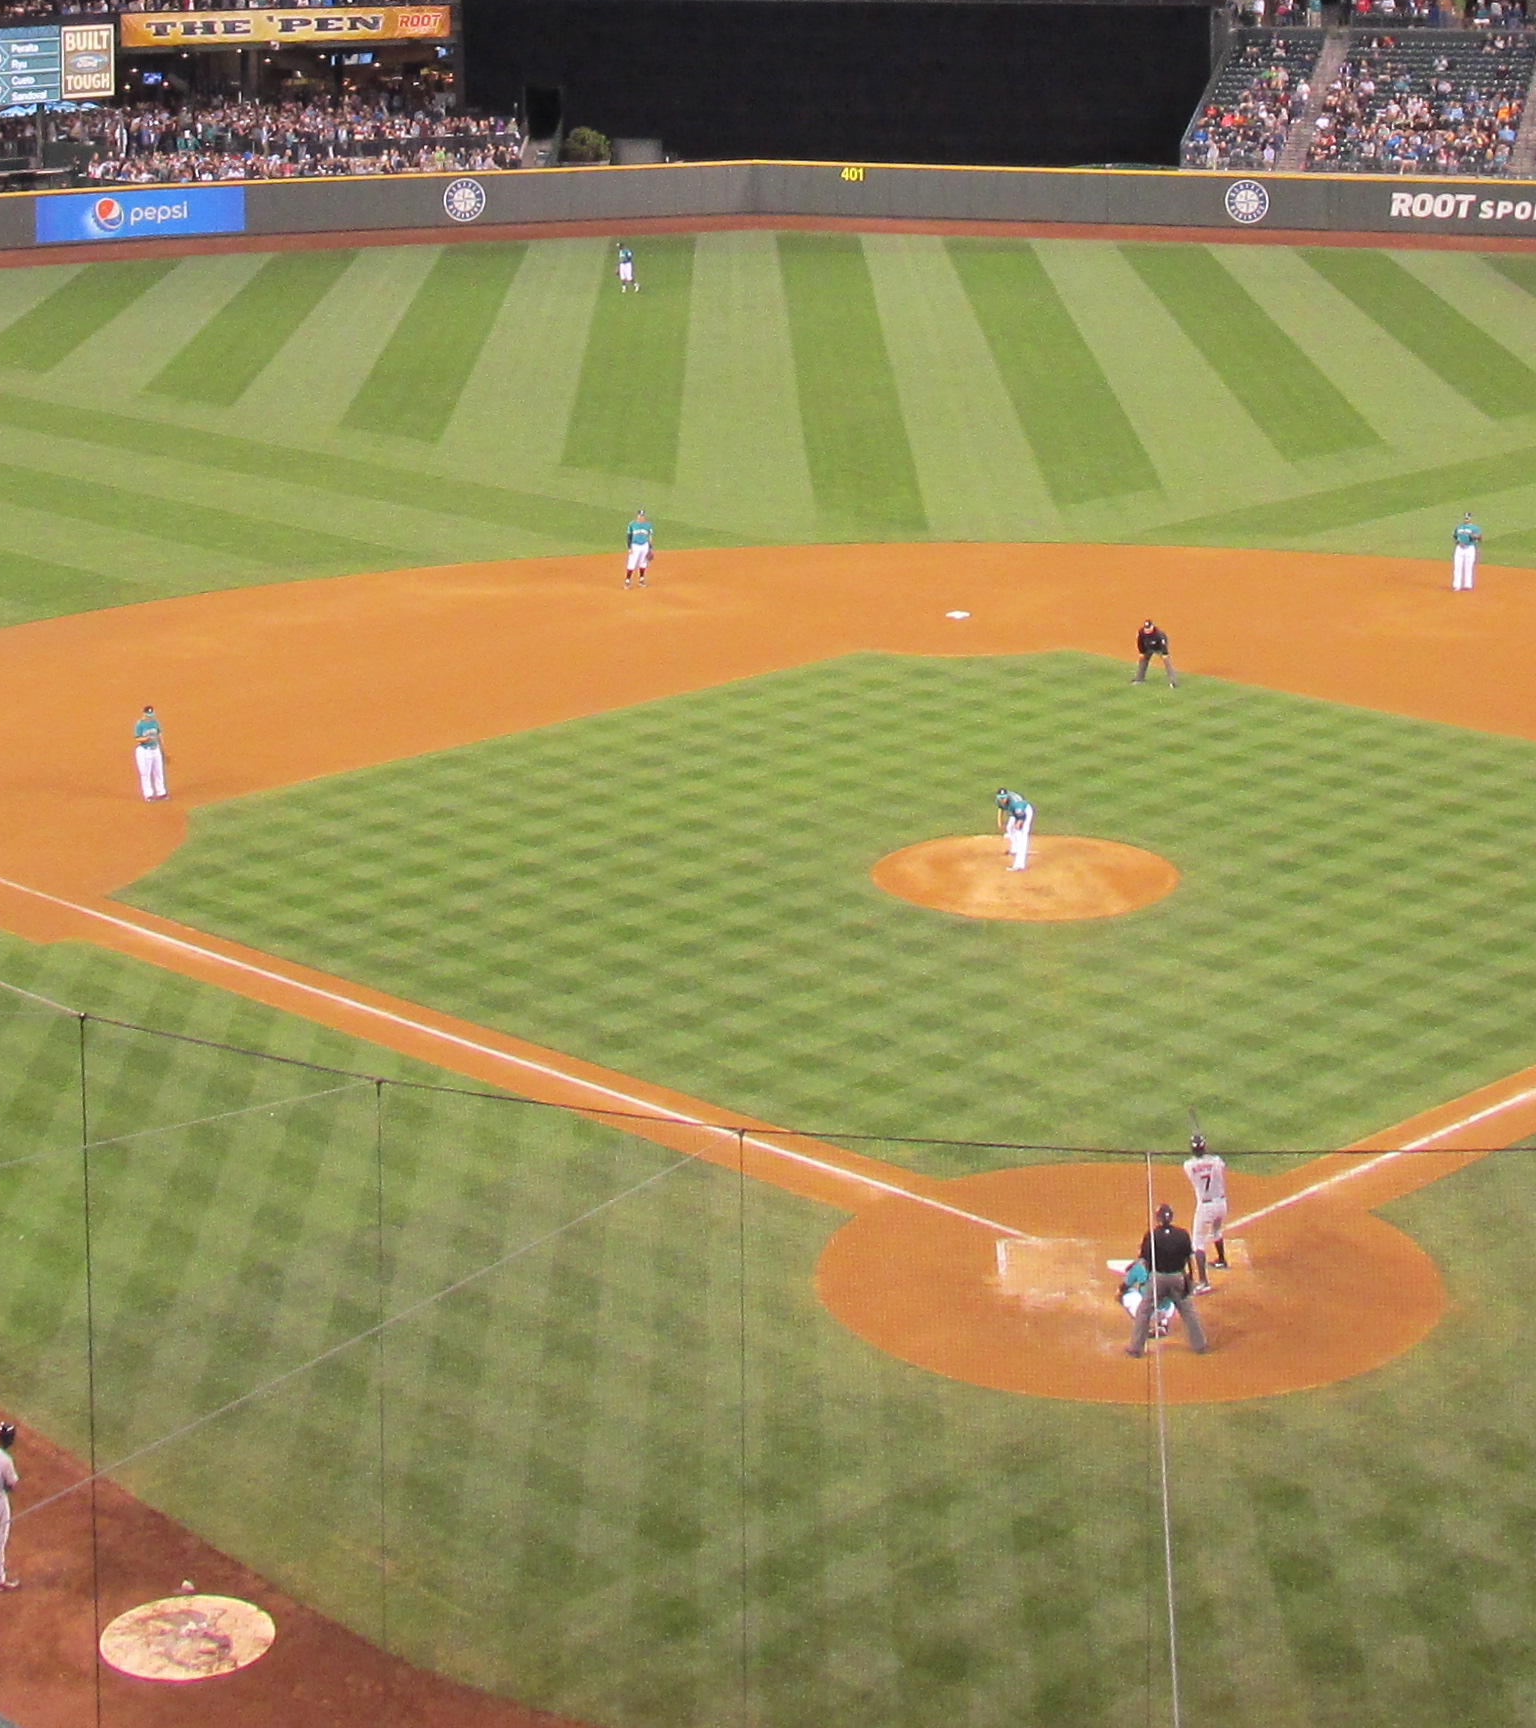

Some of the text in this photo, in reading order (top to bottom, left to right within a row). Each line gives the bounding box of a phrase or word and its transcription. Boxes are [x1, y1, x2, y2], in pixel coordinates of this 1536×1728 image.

[146, 14, 384, 37] THE 'PEN
[398, 14, 441, 28] ROOT
[66, 30, 110, 52] BUILT
[66, 73, 110, 92] TOUGH
[840, 167, 864, 182] 401
[130, 201, 188, 226] pepsi
[1390, 192, 1476, 218] ROOT
[1200, 1174, 1211, 1192] 7
